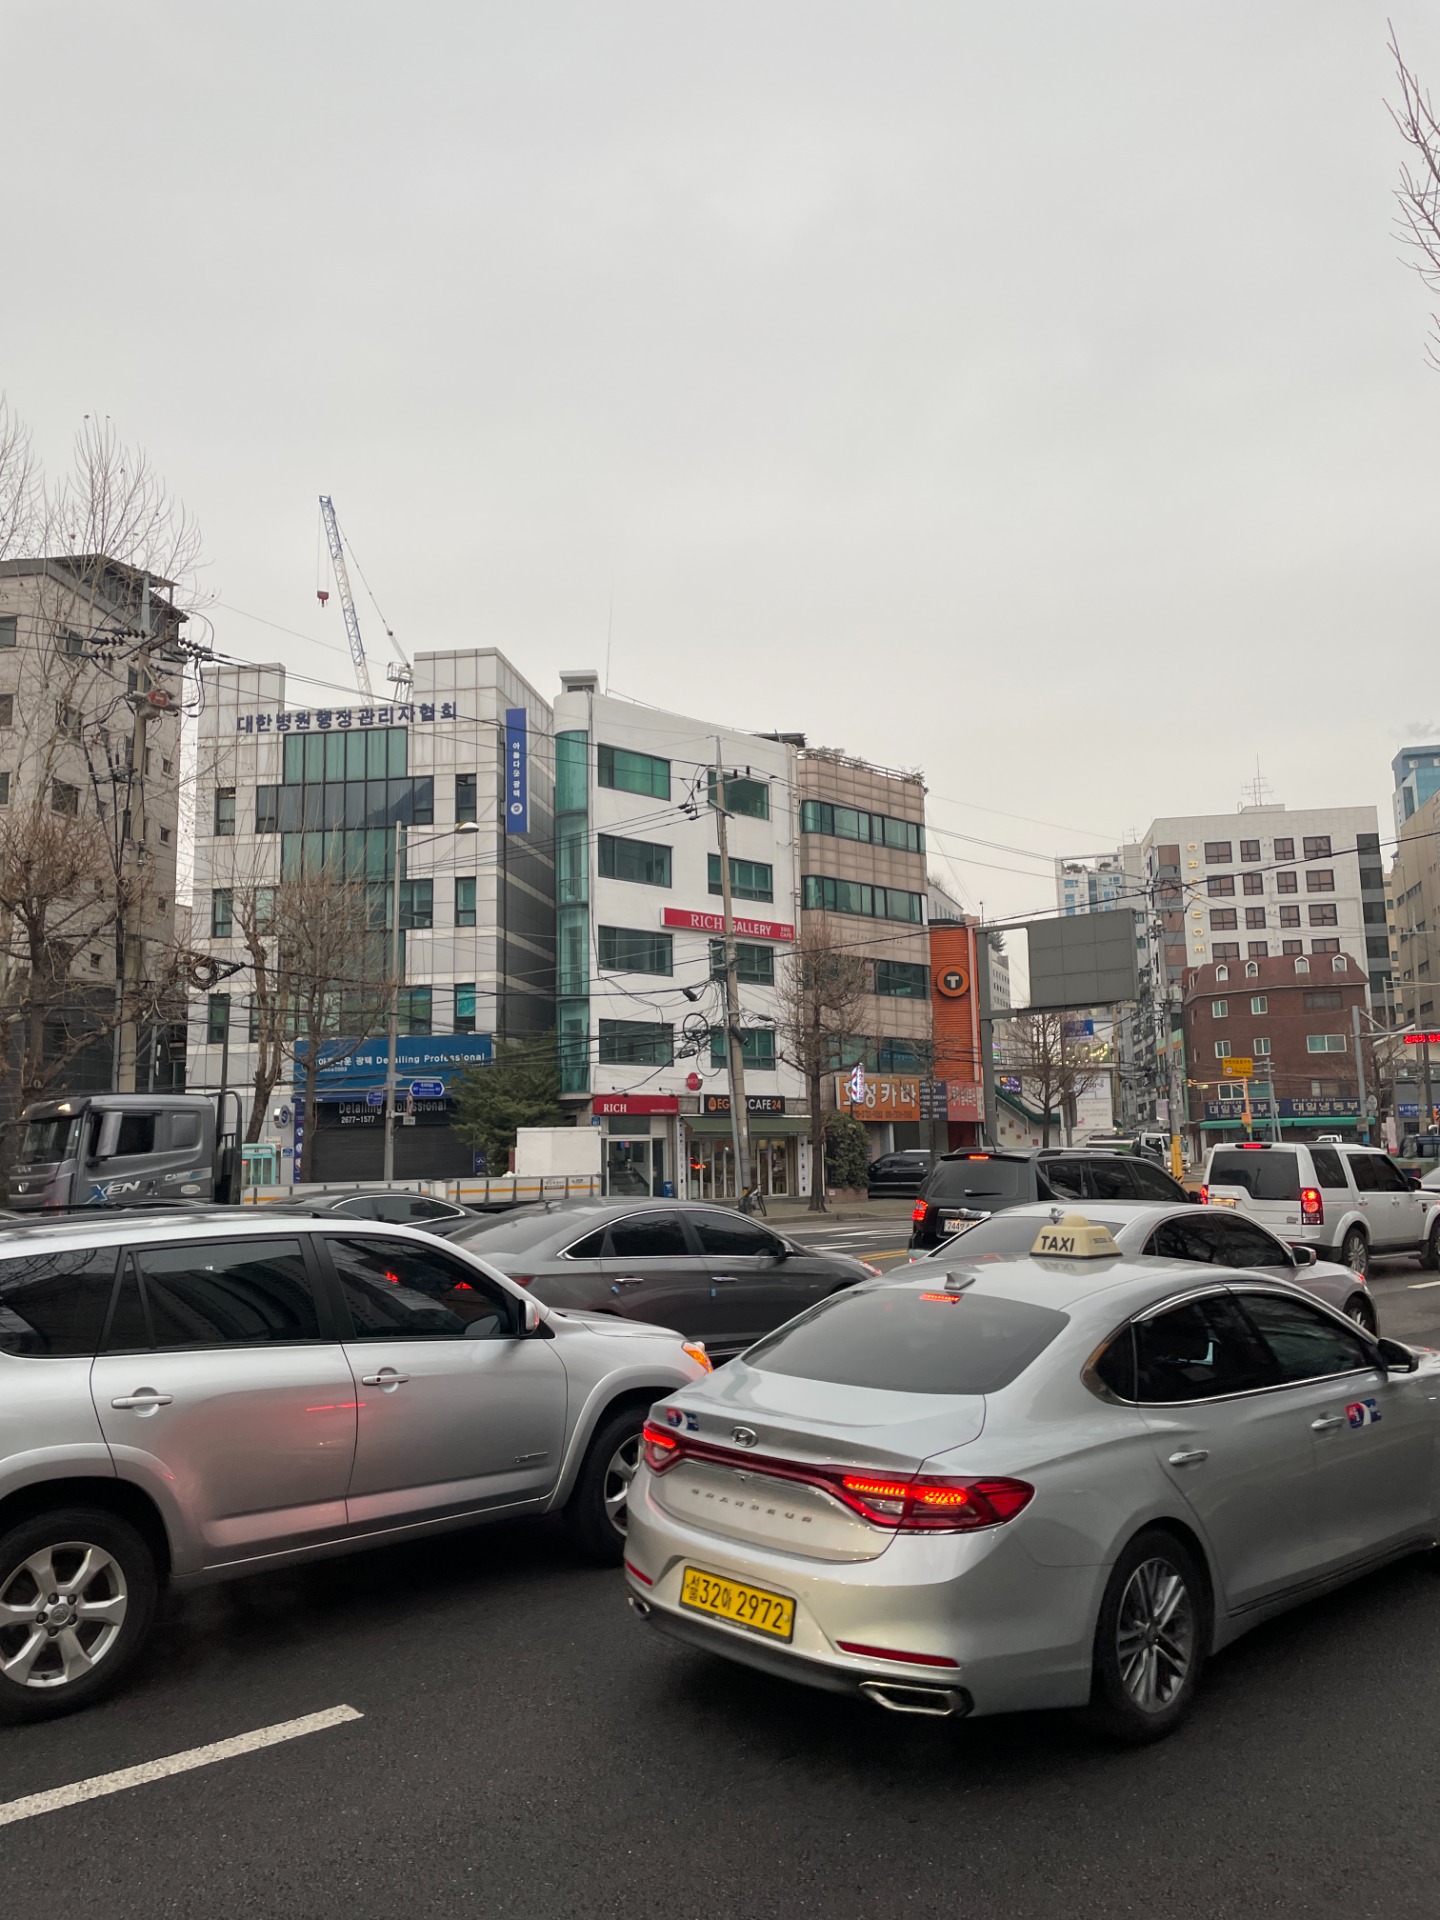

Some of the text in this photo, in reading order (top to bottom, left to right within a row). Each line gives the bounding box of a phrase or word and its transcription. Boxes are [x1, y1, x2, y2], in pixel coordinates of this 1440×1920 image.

[691, 914, 723, 930] RICH
[947, 975, 959, 988] T
[376, 1056, 420, 1064] Deailing
[603, 1103, 627, 1112] RICH
[748, 1099, 781, 1110] CAFE24
[341, 1116, 375, 1124] 2677-1577
[1041, 1235, 1075, 1252] TAXI
[691, 1487, 813, 1524] GRANDEUR
[736, 1591, 784, 1630] 2972
